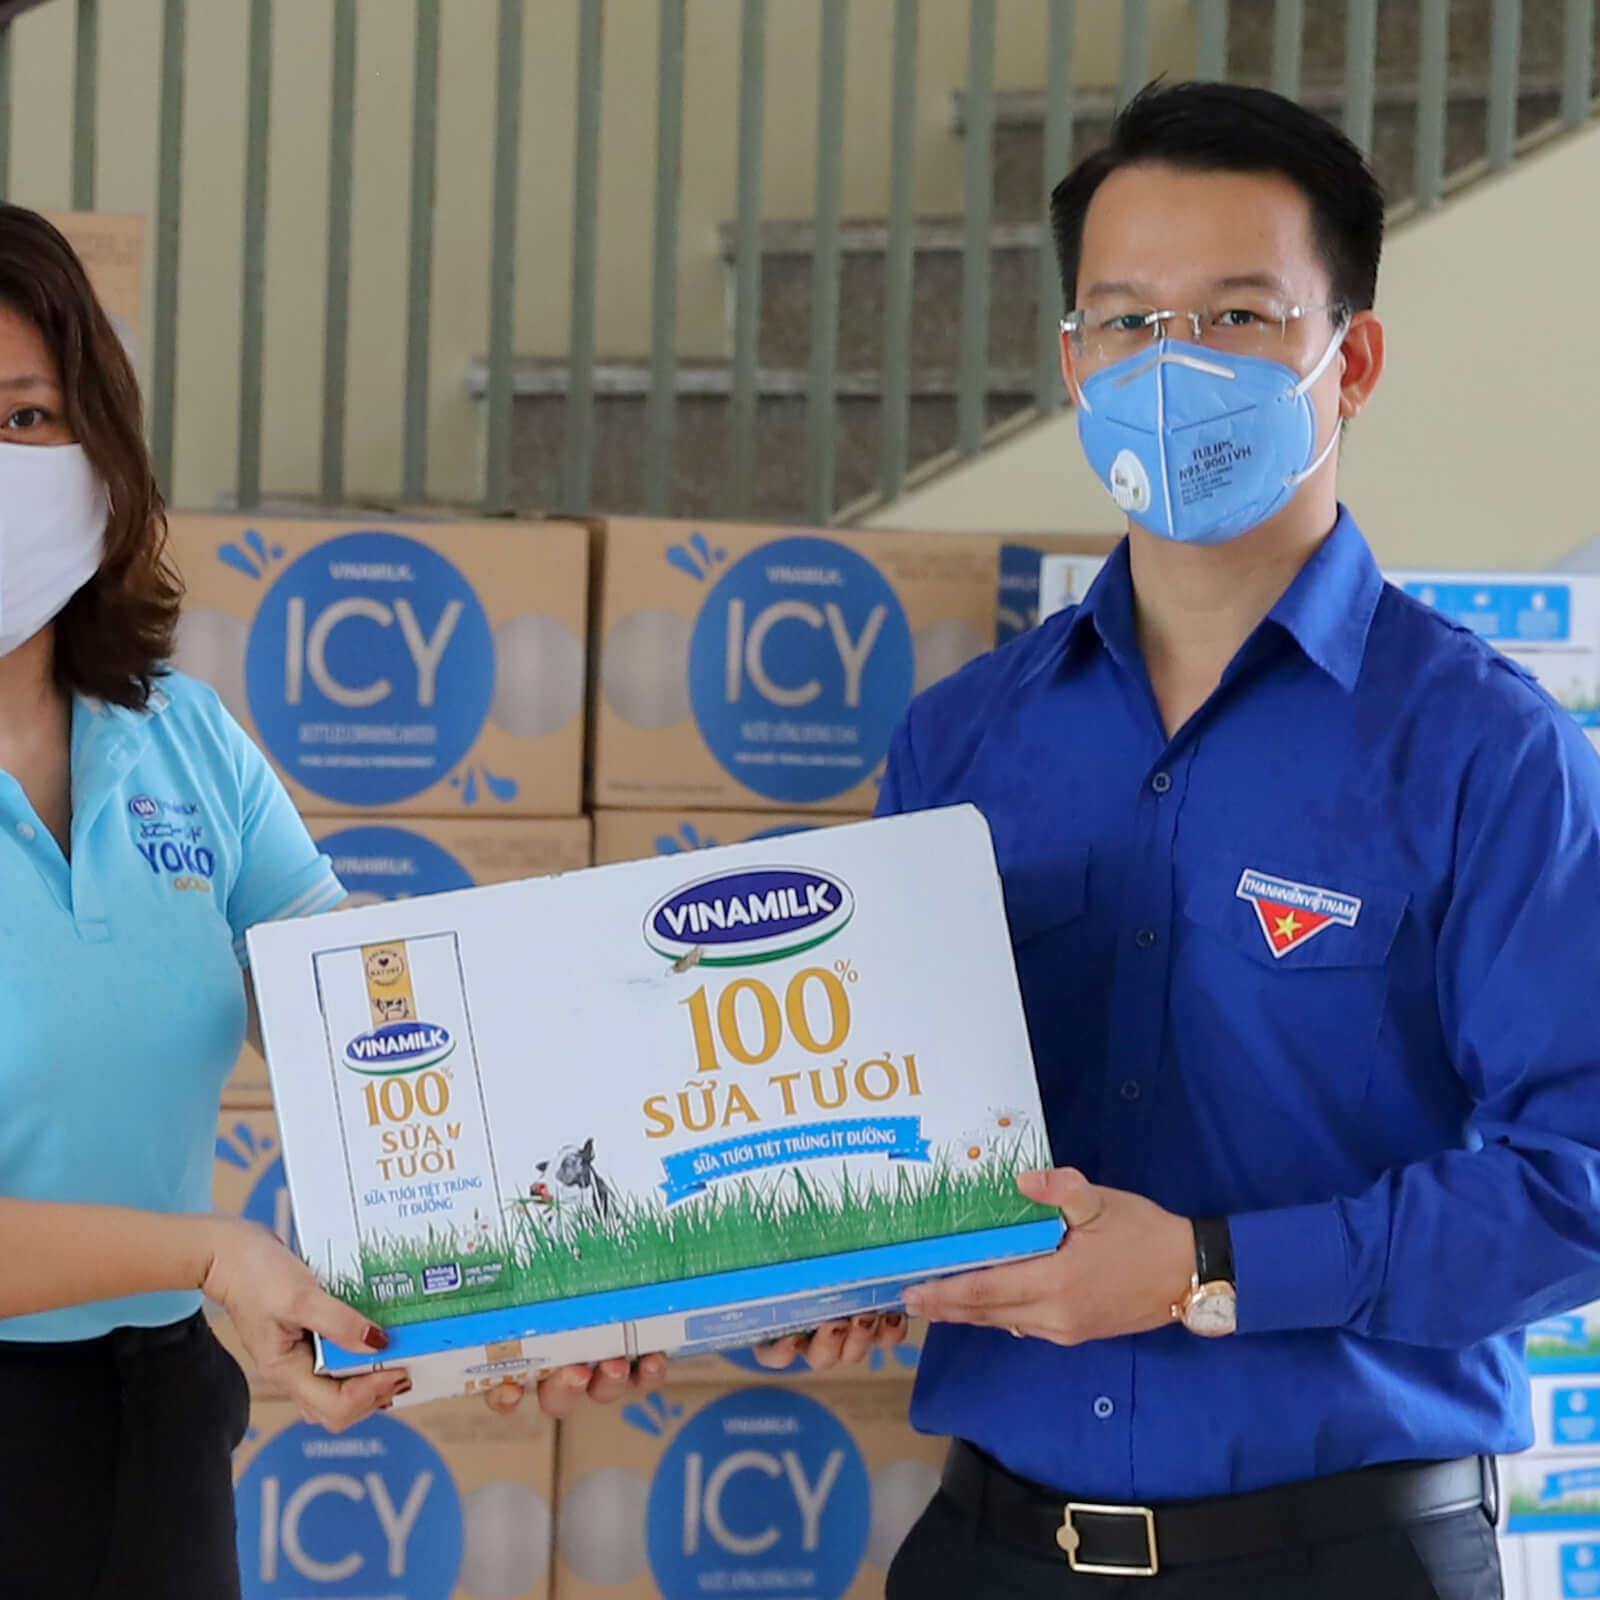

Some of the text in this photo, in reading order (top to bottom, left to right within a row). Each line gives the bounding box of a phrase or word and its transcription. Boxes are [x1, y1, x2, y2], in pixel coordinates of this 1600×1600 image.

[286, 597, 464, 707] ICY
[727, 599, 888, 707] ICY
[136, 841, 216, 878] YOKO
[663, 881, 835, 937] VINAMILK
[352, 1028, 446, 1059] VINAMILK
[643, 1052, 922, 1140] SỮA TƯƠI
[376, 1147, 458, 1182] TƯƠI
[382, 1123, 444, 1154] SỮA
[693, 1125, 897, 1175] SỮA TƯƠI TIỆT TRÙNG ÍT ĐƯỜNG
[261, 1472, 433, 1582] ICY
[684, 1450, 844, 1555] ICY
